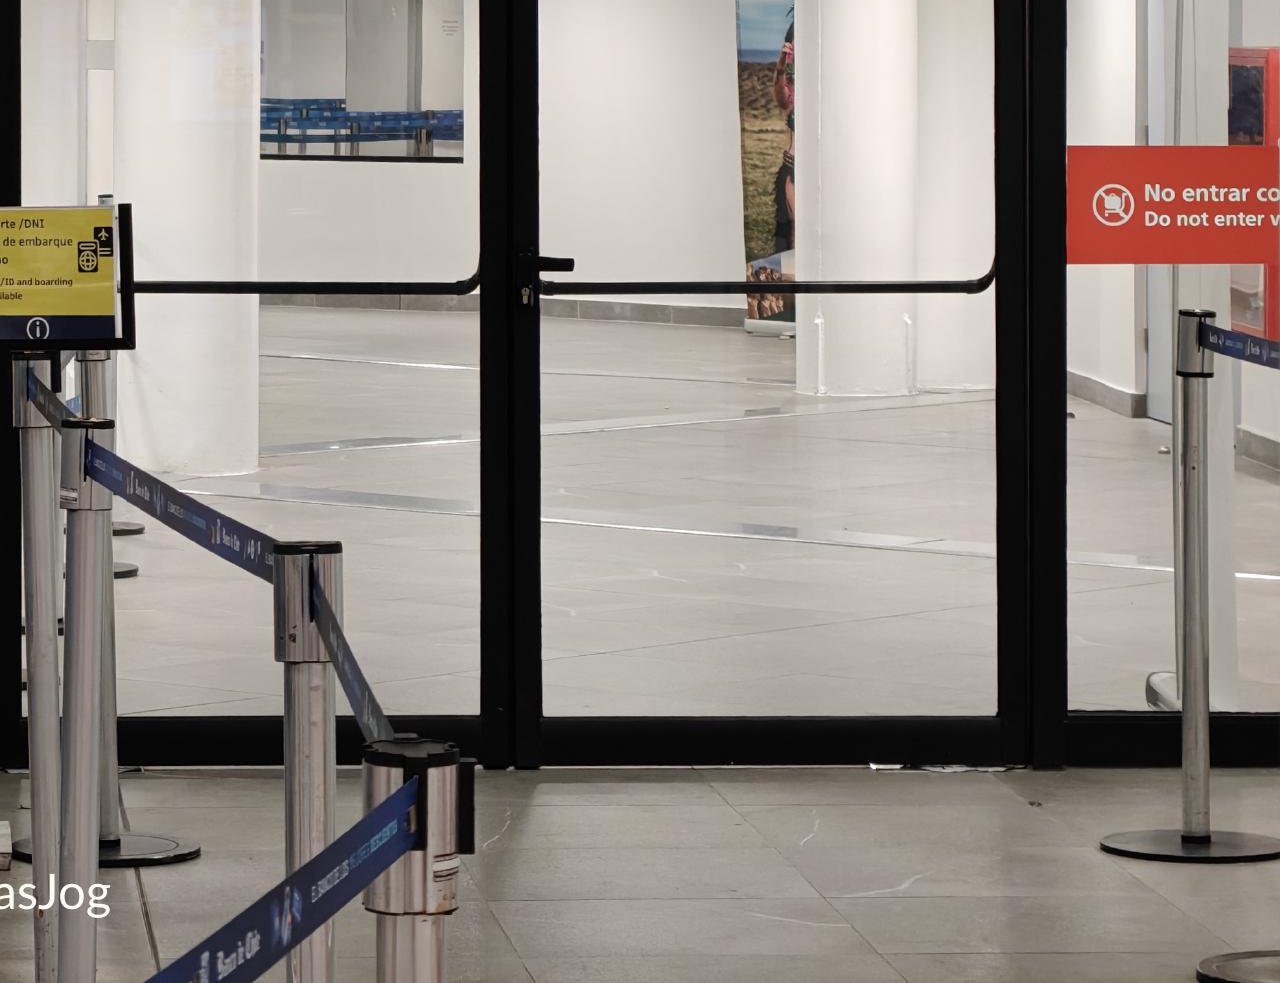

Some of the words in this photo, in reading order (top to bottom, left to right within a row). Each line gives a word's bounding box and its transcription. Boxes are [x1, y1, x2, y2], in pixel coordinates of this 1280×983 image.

[1144, 183, 1176, 202] No
[1182, 185, 1251, 202] entrar
[18, 218, 45, 231] /DNI
[1144, 210, 1171, 227] Do
[1176, 212, 1209, 227] not
[1214, 212, 1265, 227] enter
[2, 236, 16, 247] de
[18, 236, 73, 249] embarque
[16, 277, 33, 286] and
[34, 277, 73, 288] boarding
